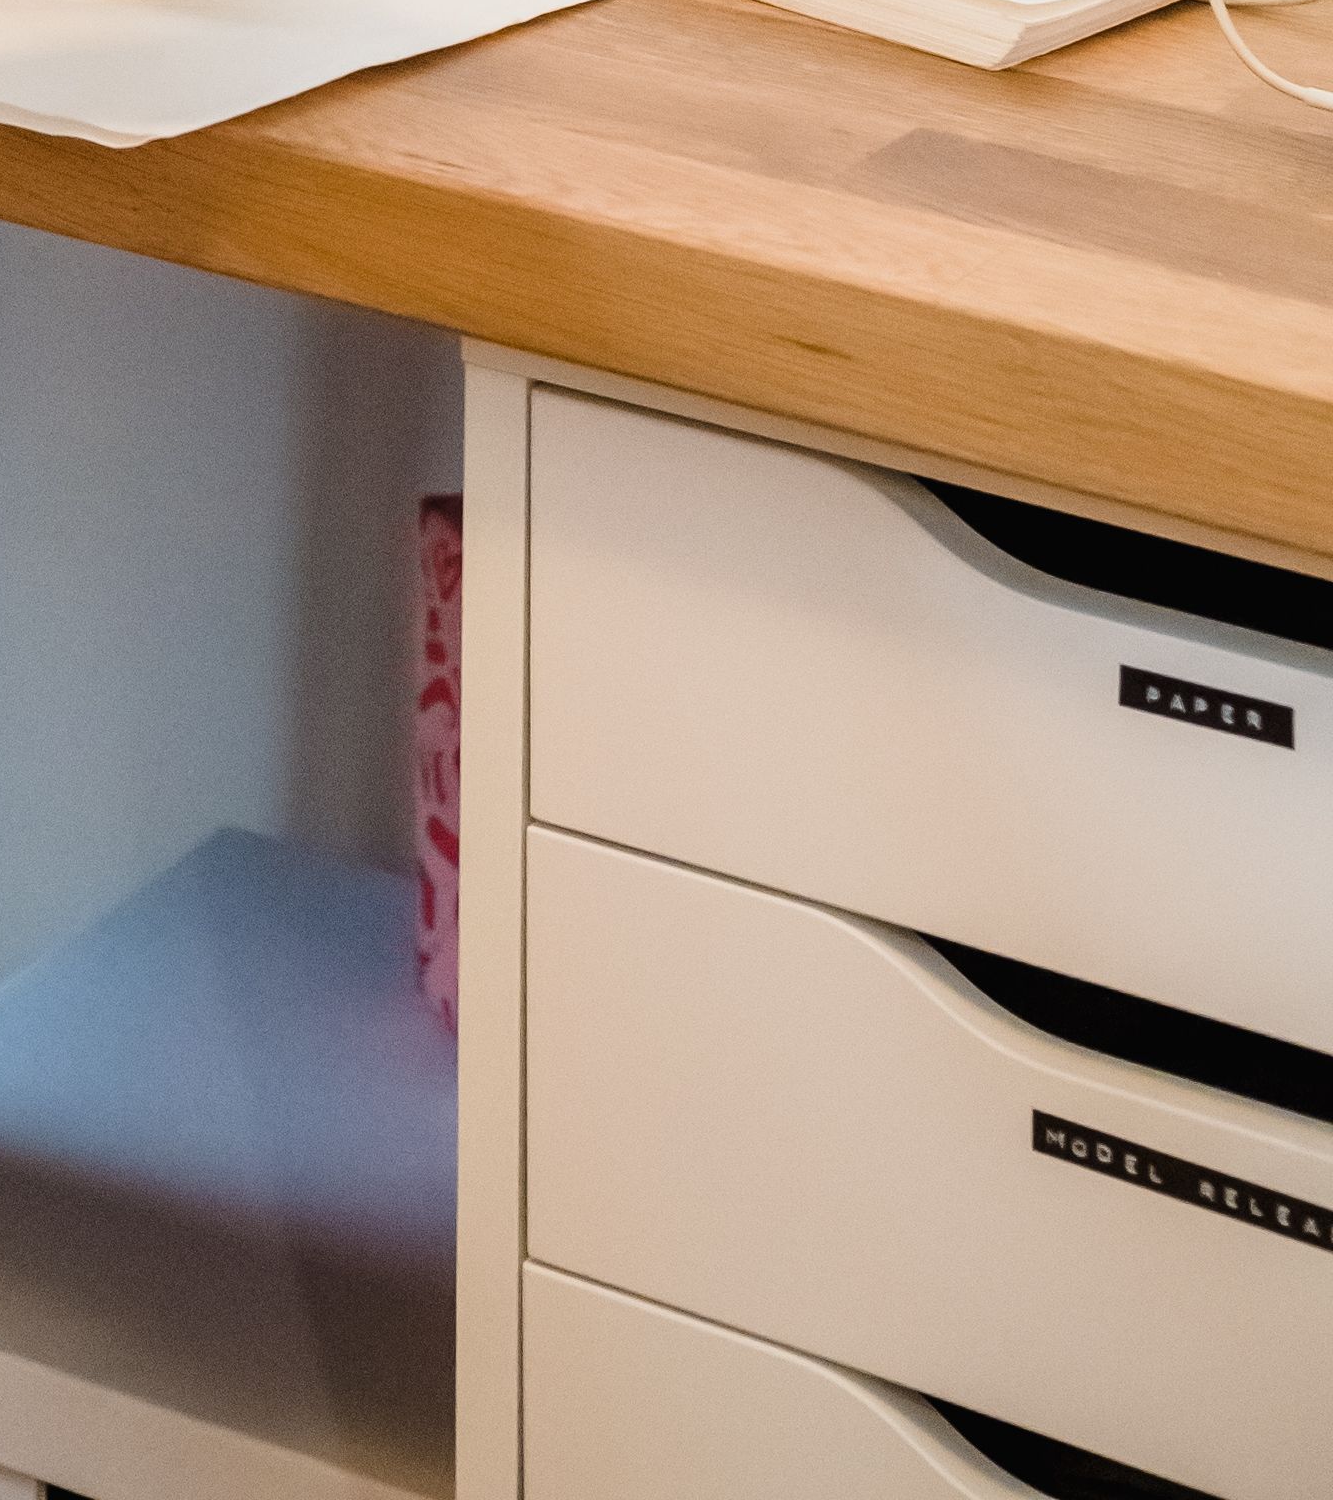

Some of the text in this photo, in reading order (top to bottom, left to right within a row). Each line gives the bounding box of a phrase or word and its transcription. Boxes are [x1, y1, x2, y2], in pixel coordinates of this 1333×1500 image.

[1146, 685, 1263, 731] PAPER
[1045, 1126, 1333, 1245] MODEL RELEA
